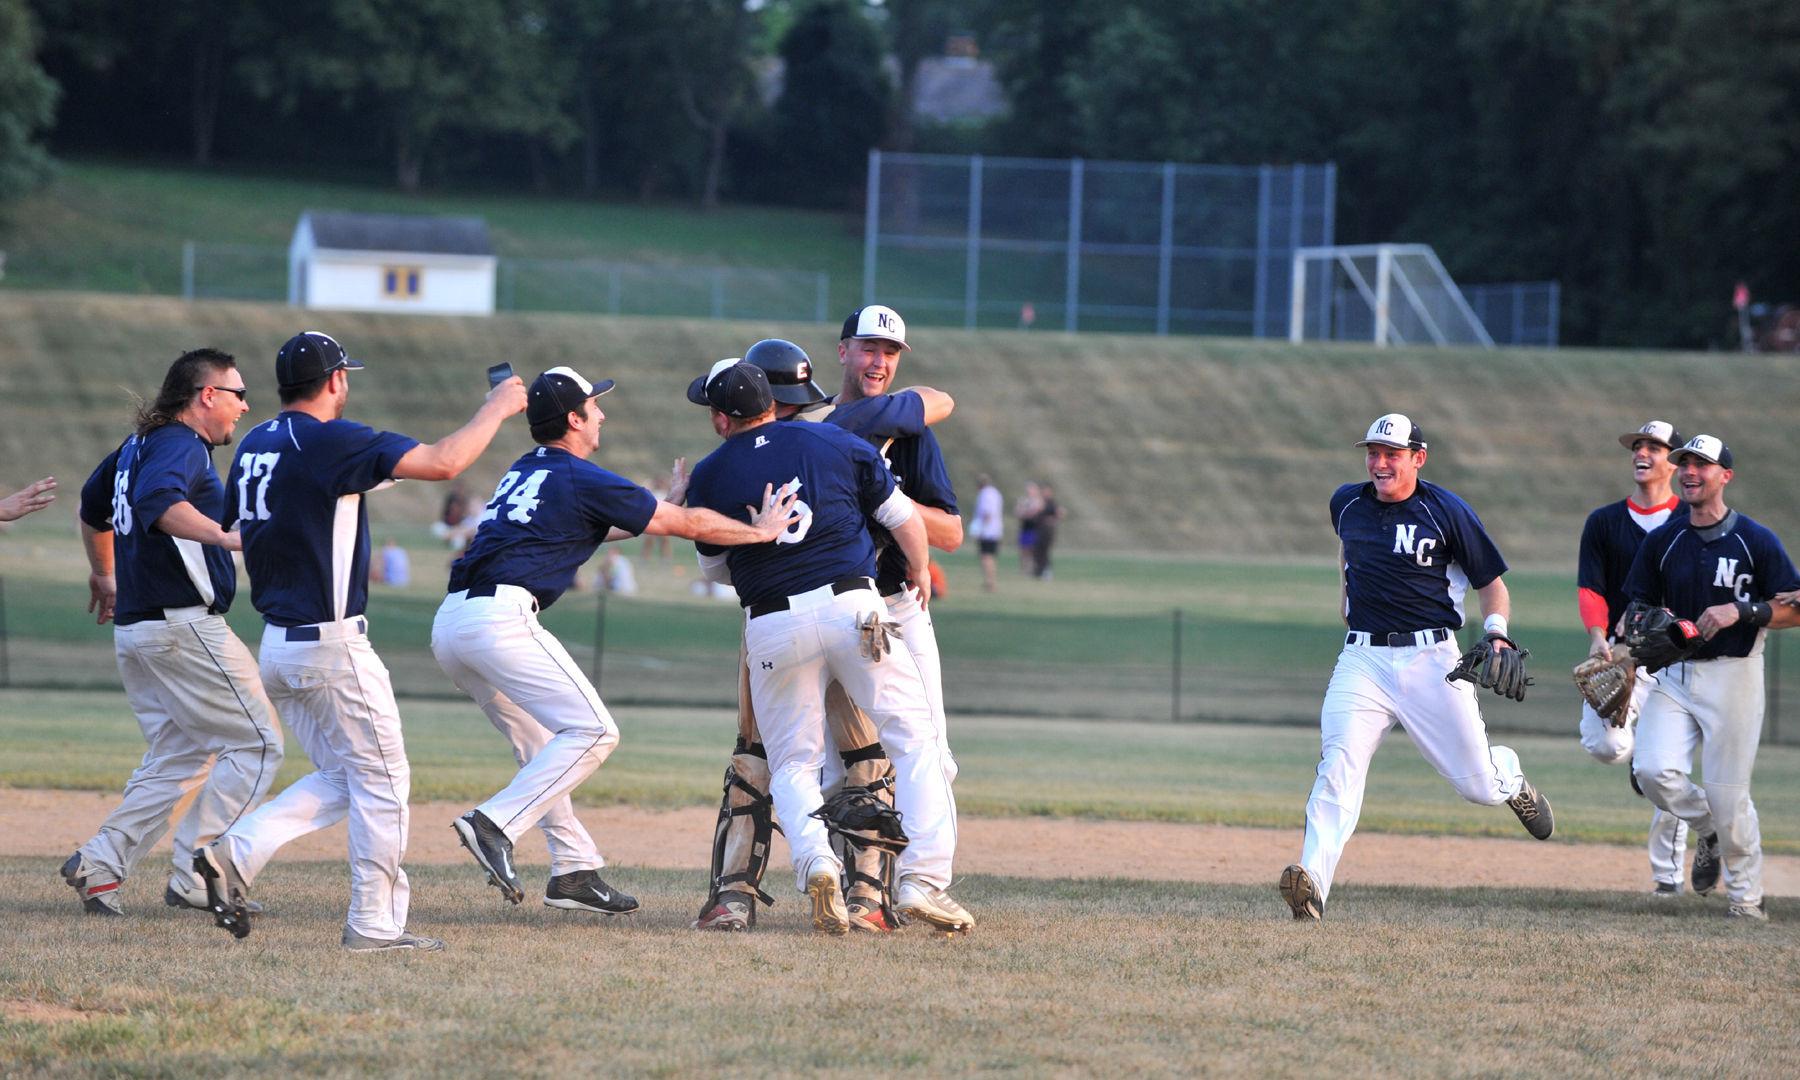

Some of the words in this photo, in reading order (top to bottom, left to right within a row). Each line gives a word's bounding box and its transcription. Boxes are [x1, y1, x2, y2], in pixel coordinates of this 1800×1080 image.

[878, 312, 896, 333] NC
[1376, 420, 1394, 436] NC
[238, 451, 280, 520] 17
[479, 469, 552, 524] 24
[1392, 523, 1437, 567] NC
[1713, 557, 1753, 603] NC
